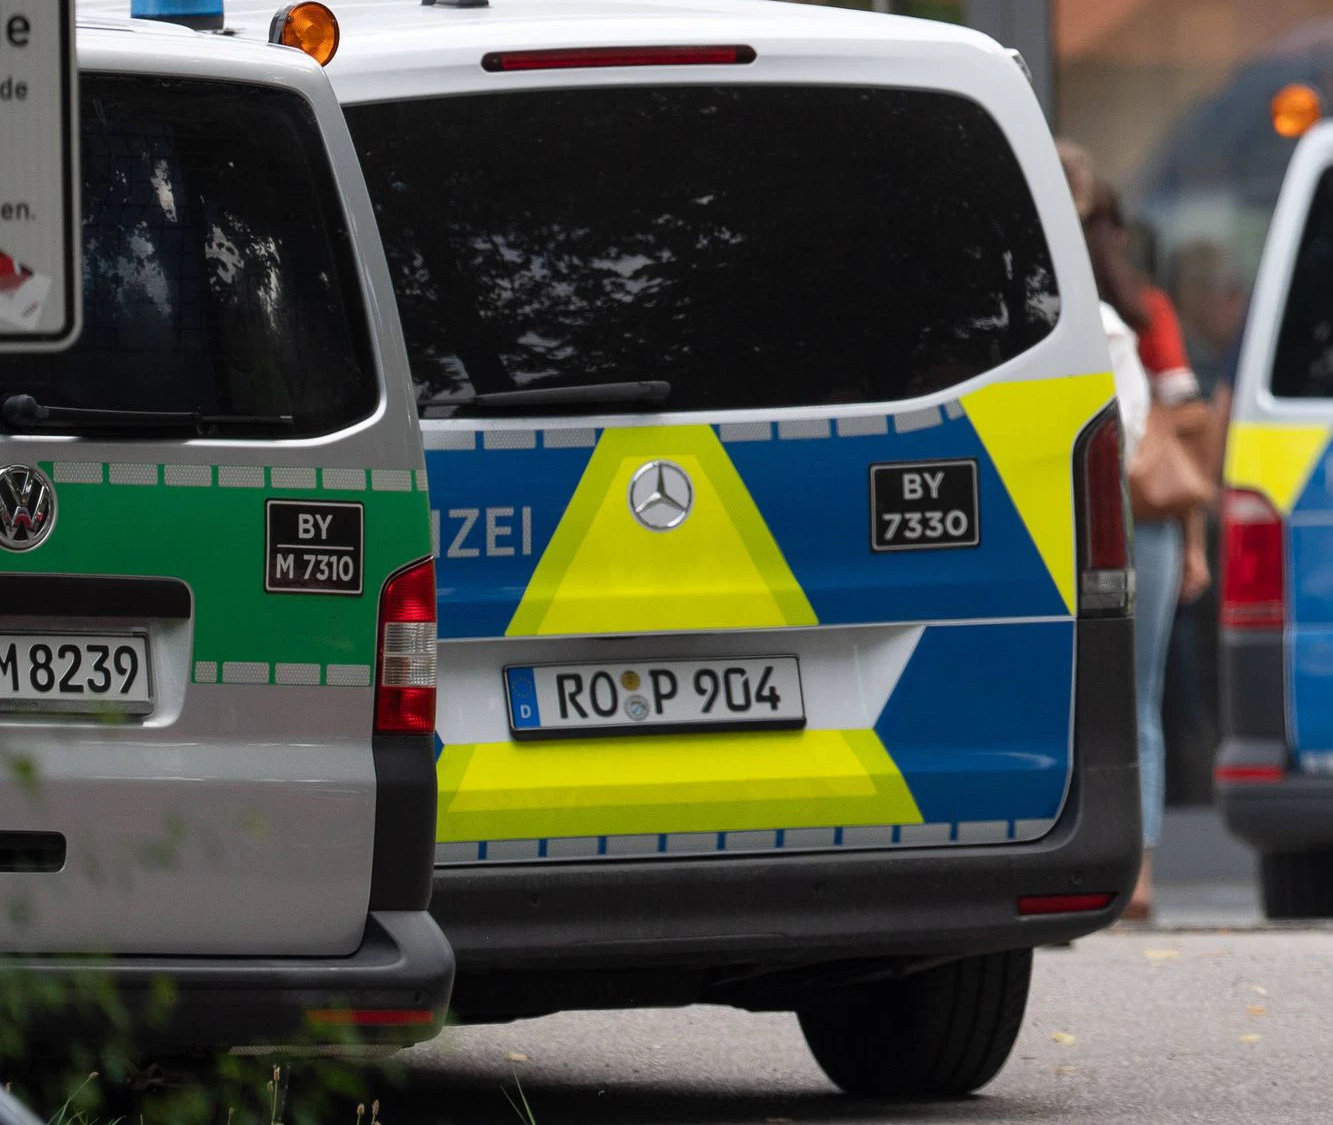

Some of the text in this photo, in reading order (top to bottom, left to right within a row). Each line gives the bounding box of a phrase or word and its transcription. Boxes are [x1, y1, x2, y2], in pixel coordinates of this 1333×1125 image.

[903, 472, 945, 500] BY
[298, 514, 333, 540] BY
[882, 510, 968, 541] 7330
[276, 553, 354, 582] M 7310
[520, 666, 781, 719] D RO P 904
